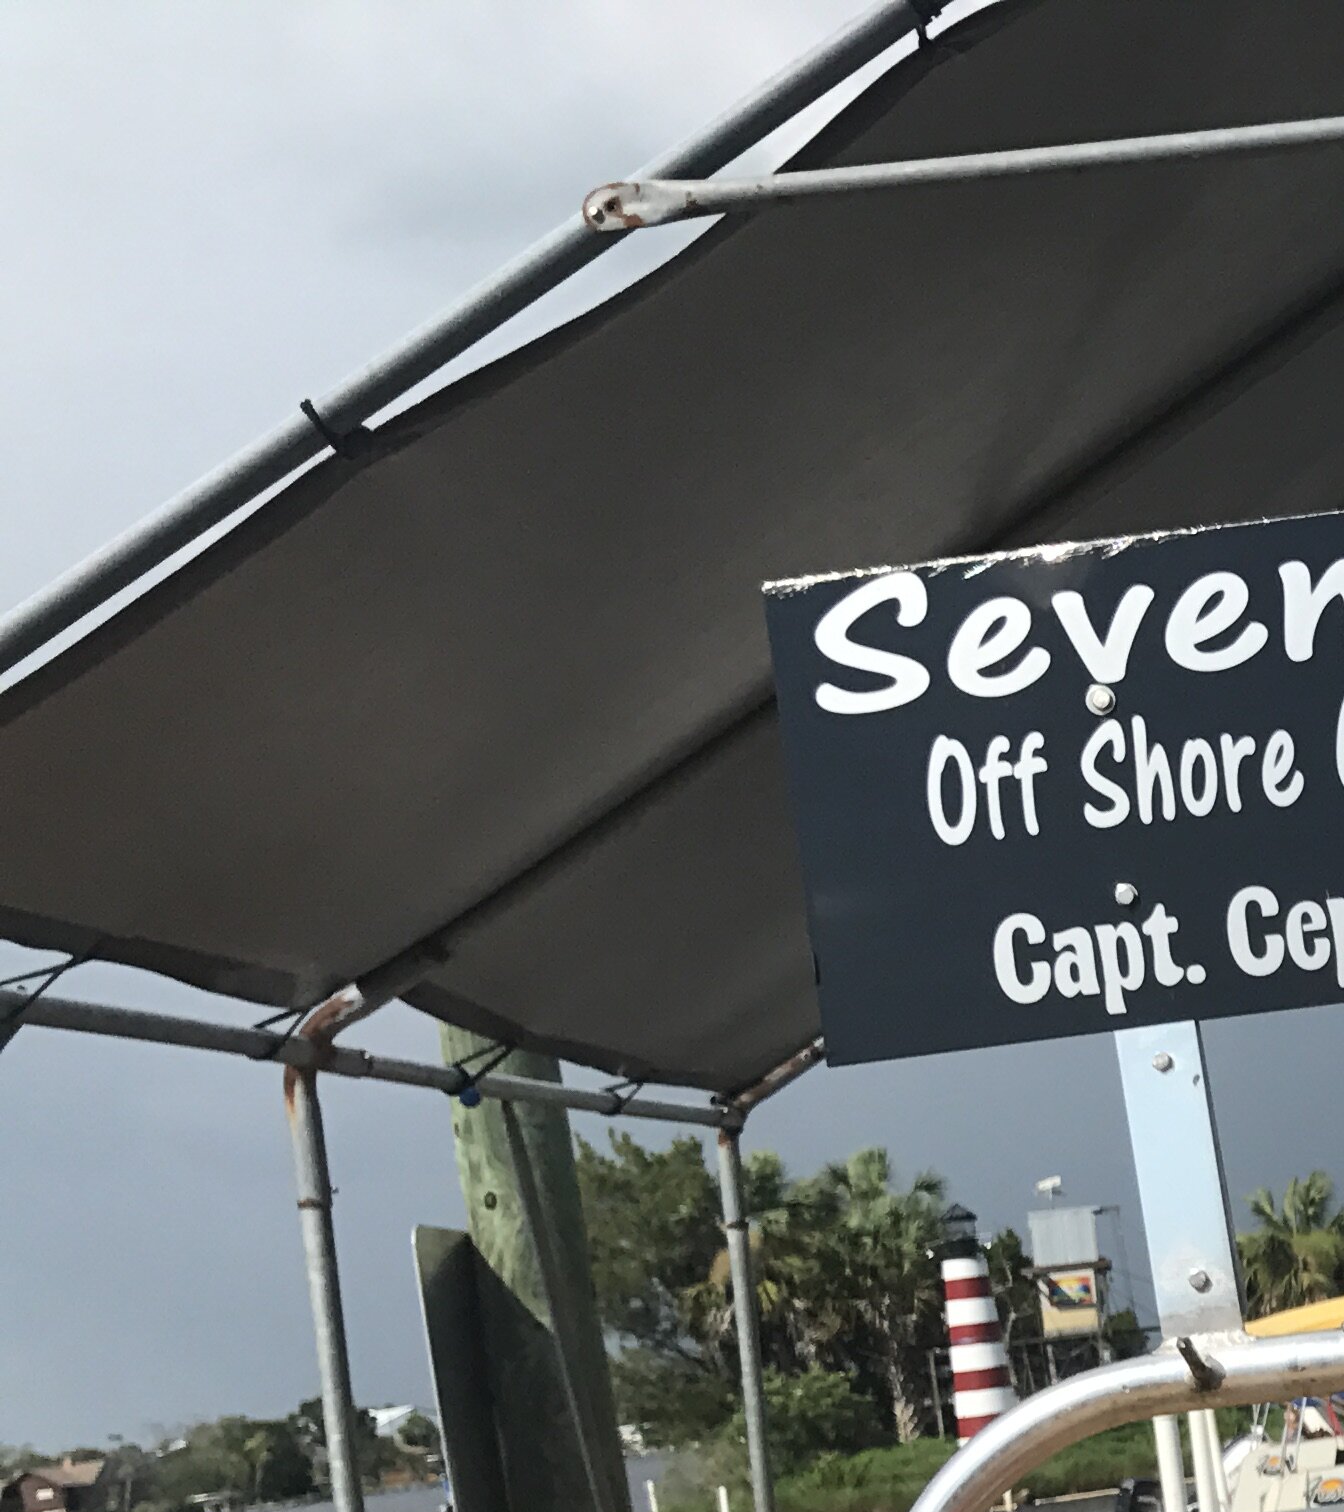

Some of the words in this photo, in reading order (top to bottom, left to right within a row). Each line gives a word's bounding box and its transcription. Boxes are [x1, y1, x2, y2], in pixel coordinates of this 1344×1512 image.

[926, 733, 1049, 847] Off
[1081, 714, 1305, 830] Shore
[992, 902, 1208, 1016] Capt.
